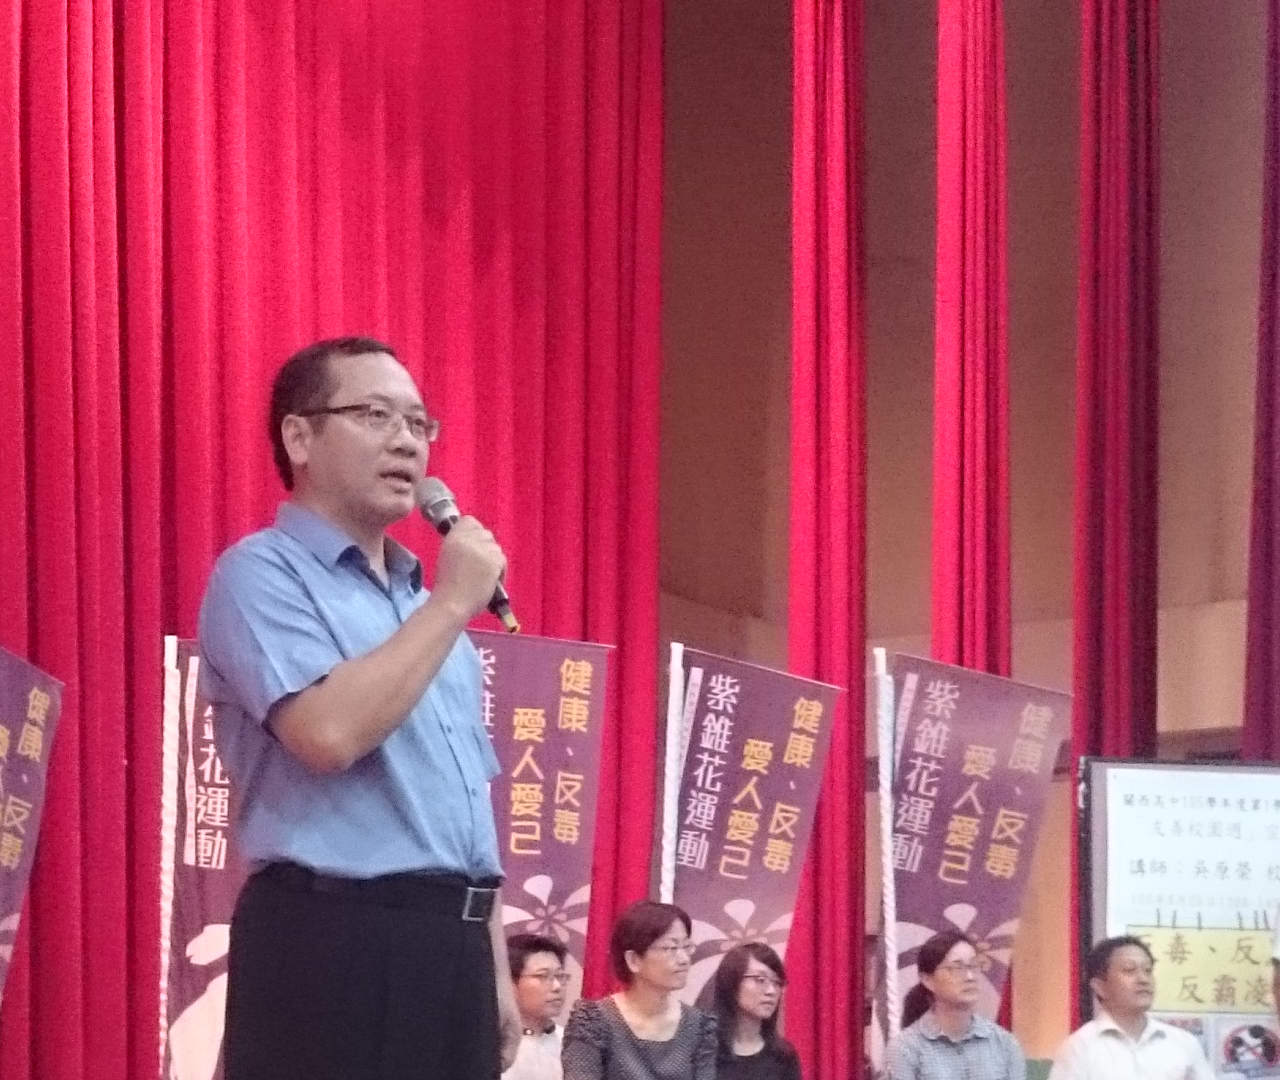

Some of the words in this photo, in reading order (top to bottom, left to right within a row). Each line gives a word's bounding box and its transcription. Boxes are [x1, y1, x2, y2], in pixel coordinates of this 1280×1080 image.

[509, 707, 547, 855] 愛人愛己
[552, 657, 594, 846] 健康、反毒
[676, 673, 741, 870] 紫錐花運動
[719, 737, 774, 880] 愛人愛己
[763, 696, 824, 875] 健康、反毒
[892, 679, 961, 874] 紫錐花運動
[938, 744, 997, 885] 愛人愛己
[985, 701, 1055, 880] 健康、反毒
[1179, 974, 1271, 1008] 反霸凌
